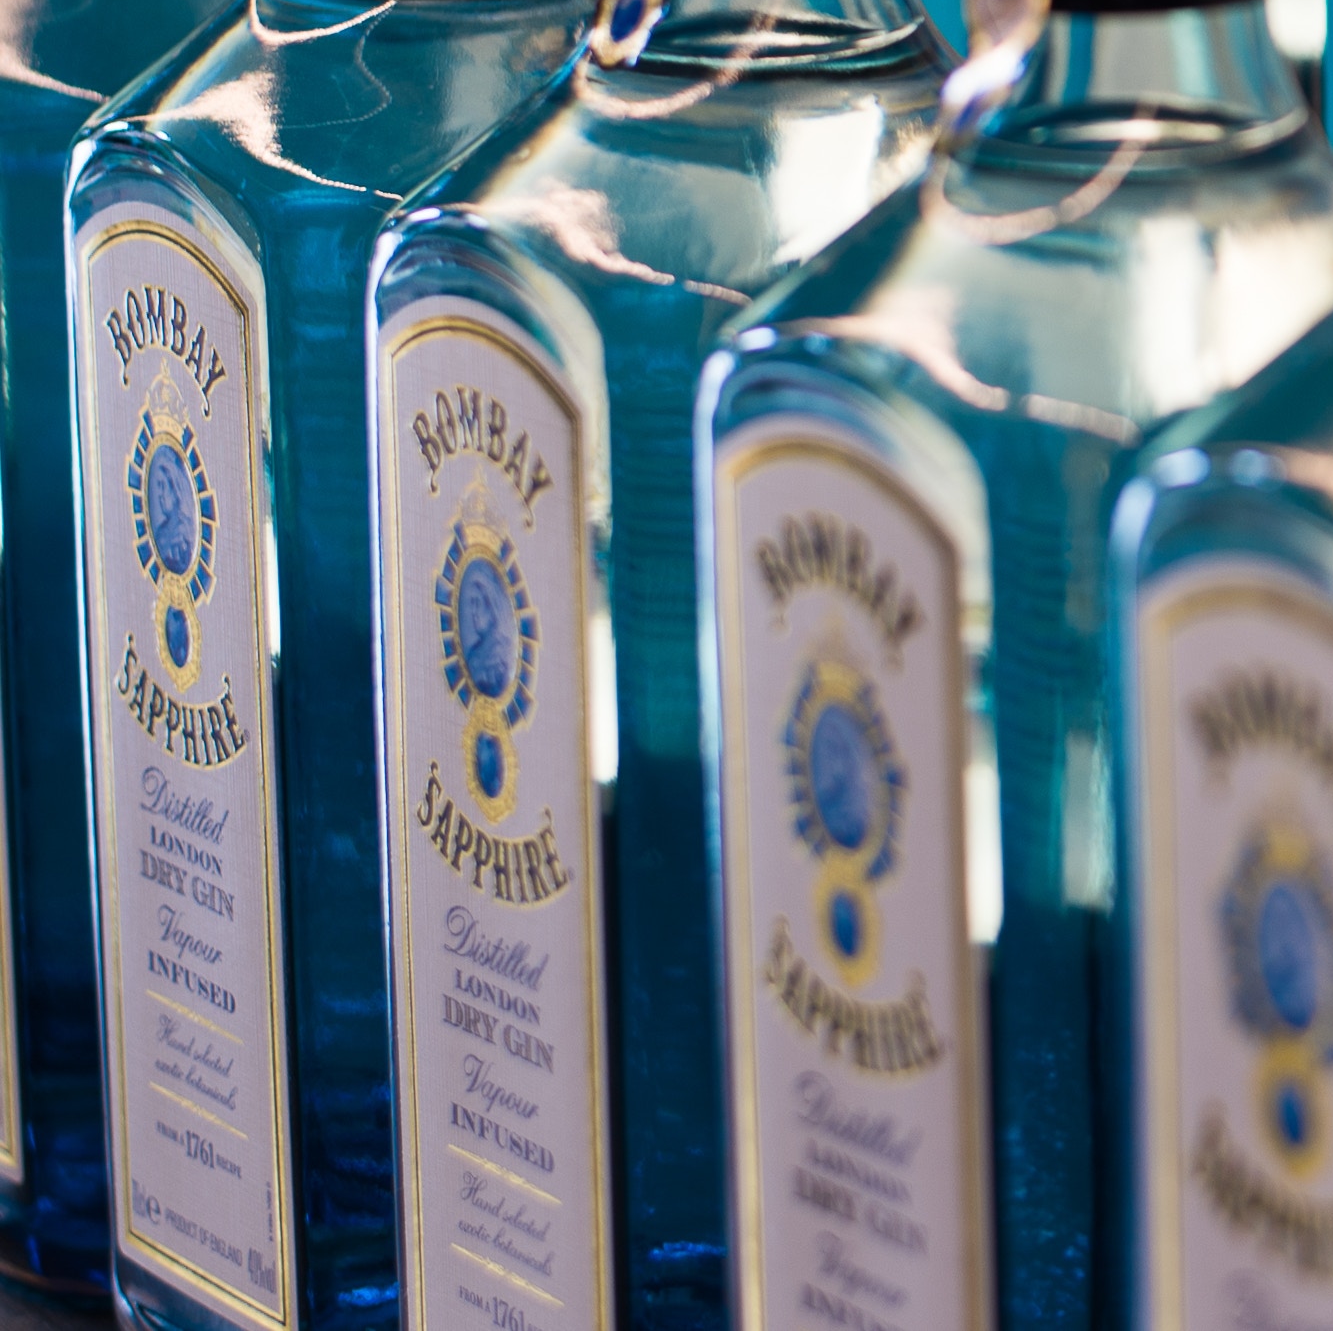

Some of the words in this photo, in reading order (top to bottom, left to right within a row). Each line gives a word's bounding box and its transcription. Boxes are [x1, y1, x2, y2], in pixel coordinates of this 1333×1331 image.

[104, 284, 227, 420] BOMBAY
[411, 383, 556, 532] BOMBAY
[114, 631, 247, 770] SAPPHIRE
[139, 765, 229, 846] Distilled
[415, 759, 569, 906] SAPPHIRE
[139, 848, 188, 897] DRY
[191, 875, 235, 922] GIN
[150, 824, 223, 877] LONDON
[158, 902, 223, 960] Vapour
[443, 905, 550, 993] Distilled
[148, 949, 236, 1014] INFUSED
[455, 967, 541, 1027] LONDON
[442, 993, 499, 1046] DRY
[503, 1023, 555, 1075] GIN
[463, 1053, 540, 1119] Vapour
[186, 1129, 216, 1170] 1761
[450, 1100, 556, 1173] INFUSED
[460, 1170, 506, 1218] Hand
[459, 1285, 483, 1310] FROM
[484, 1300, 492, 1314] A
[492, 1295, 526, 1331] 1761
